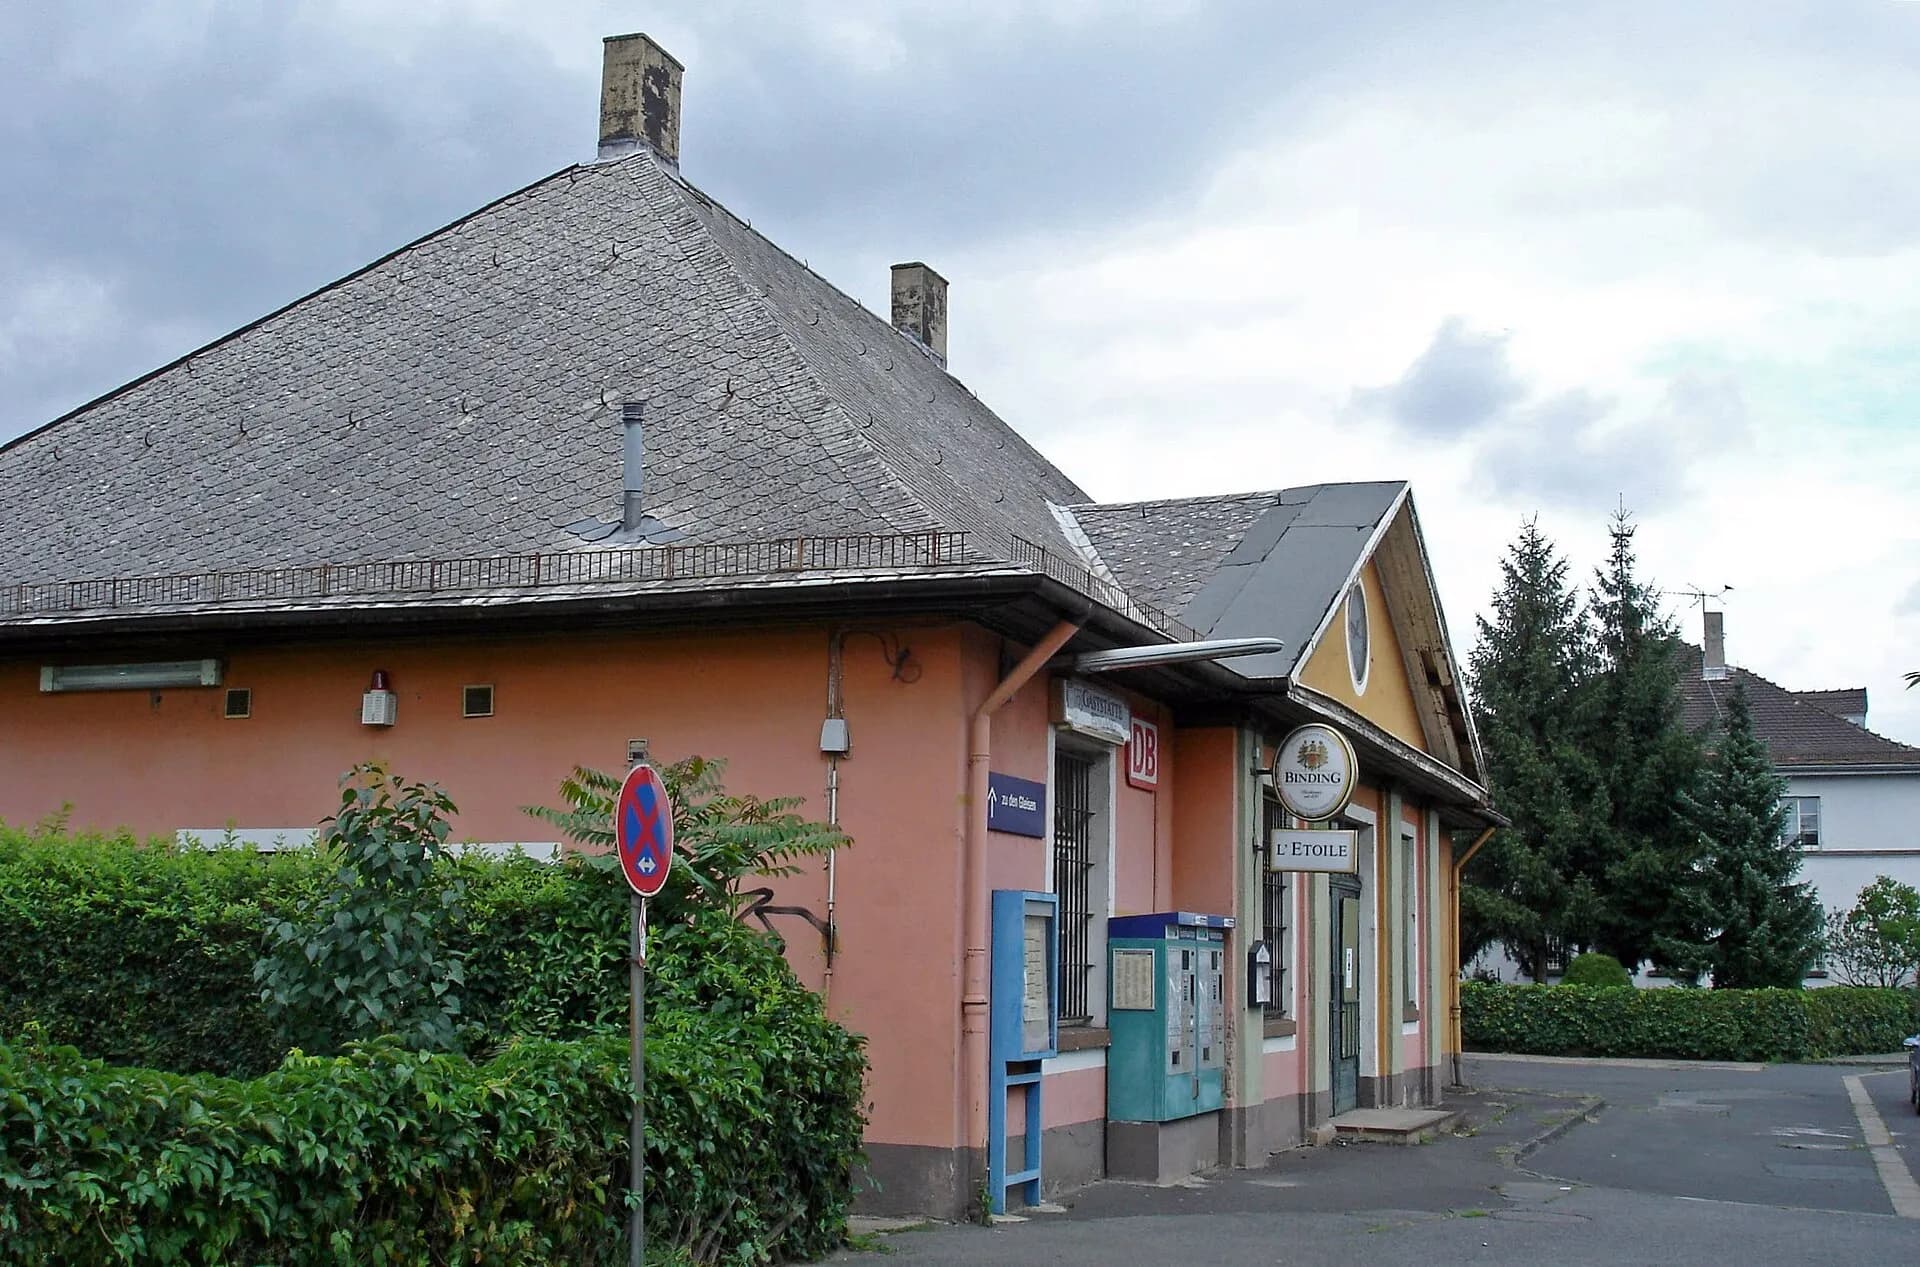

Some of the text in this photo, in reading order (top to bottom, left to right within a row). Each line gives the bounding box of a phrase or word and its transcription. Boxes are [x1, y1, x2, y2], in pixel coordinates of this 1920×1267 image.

[1133, 723, 1156, 777] DB
[1285, 771, 1341, 784] BINDING
[1001, 793, 1037, 812] zu den Gleisen
